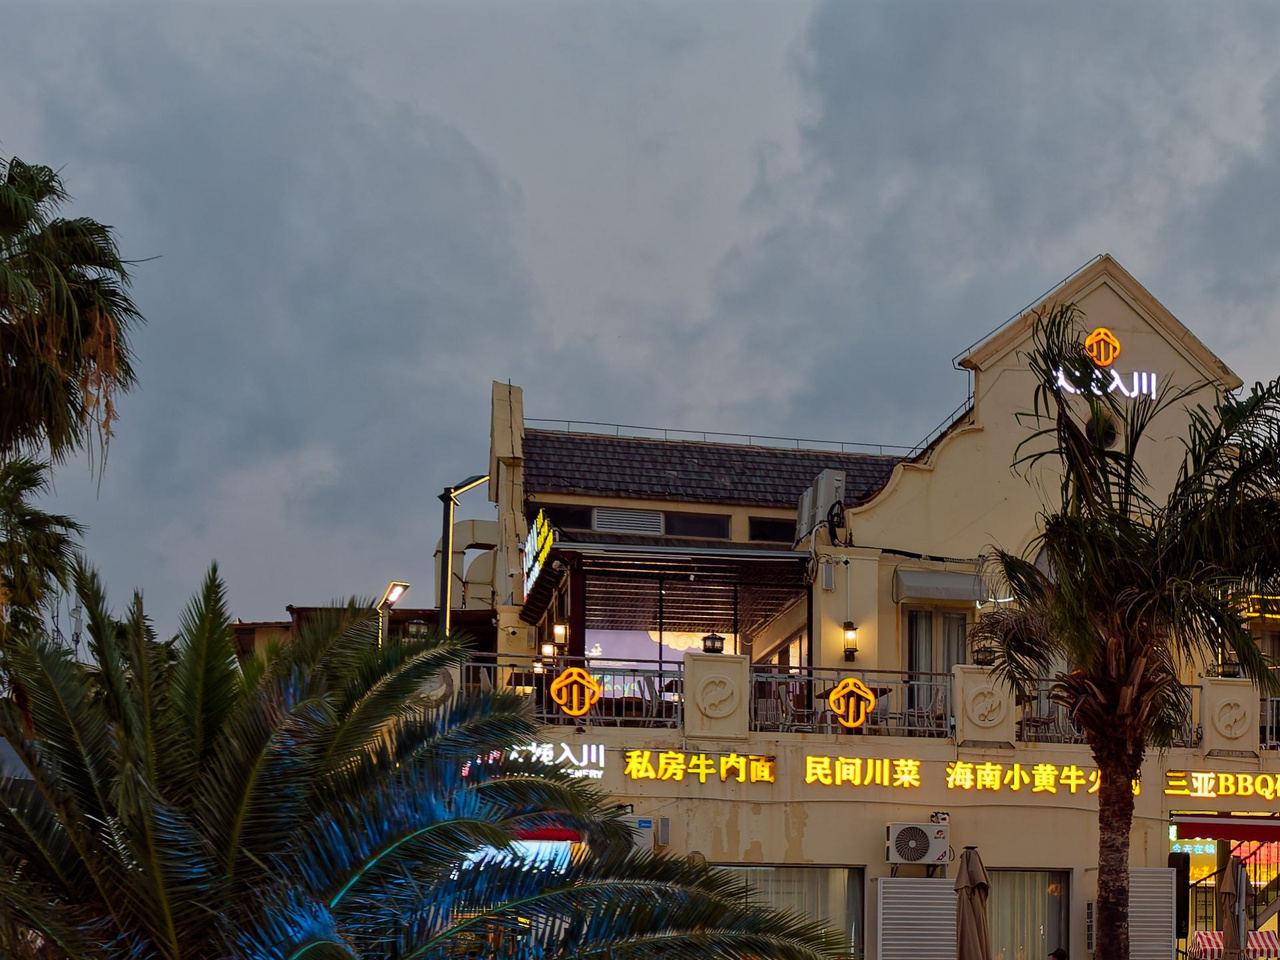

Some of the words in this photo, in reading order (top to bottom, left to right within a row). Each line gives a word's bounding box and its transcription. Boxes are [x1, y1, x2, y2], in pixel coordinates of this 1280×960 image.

[805, 755, 921, 788] 民间川菜
[946, 761, 1141, 796] 海南小黄牛
